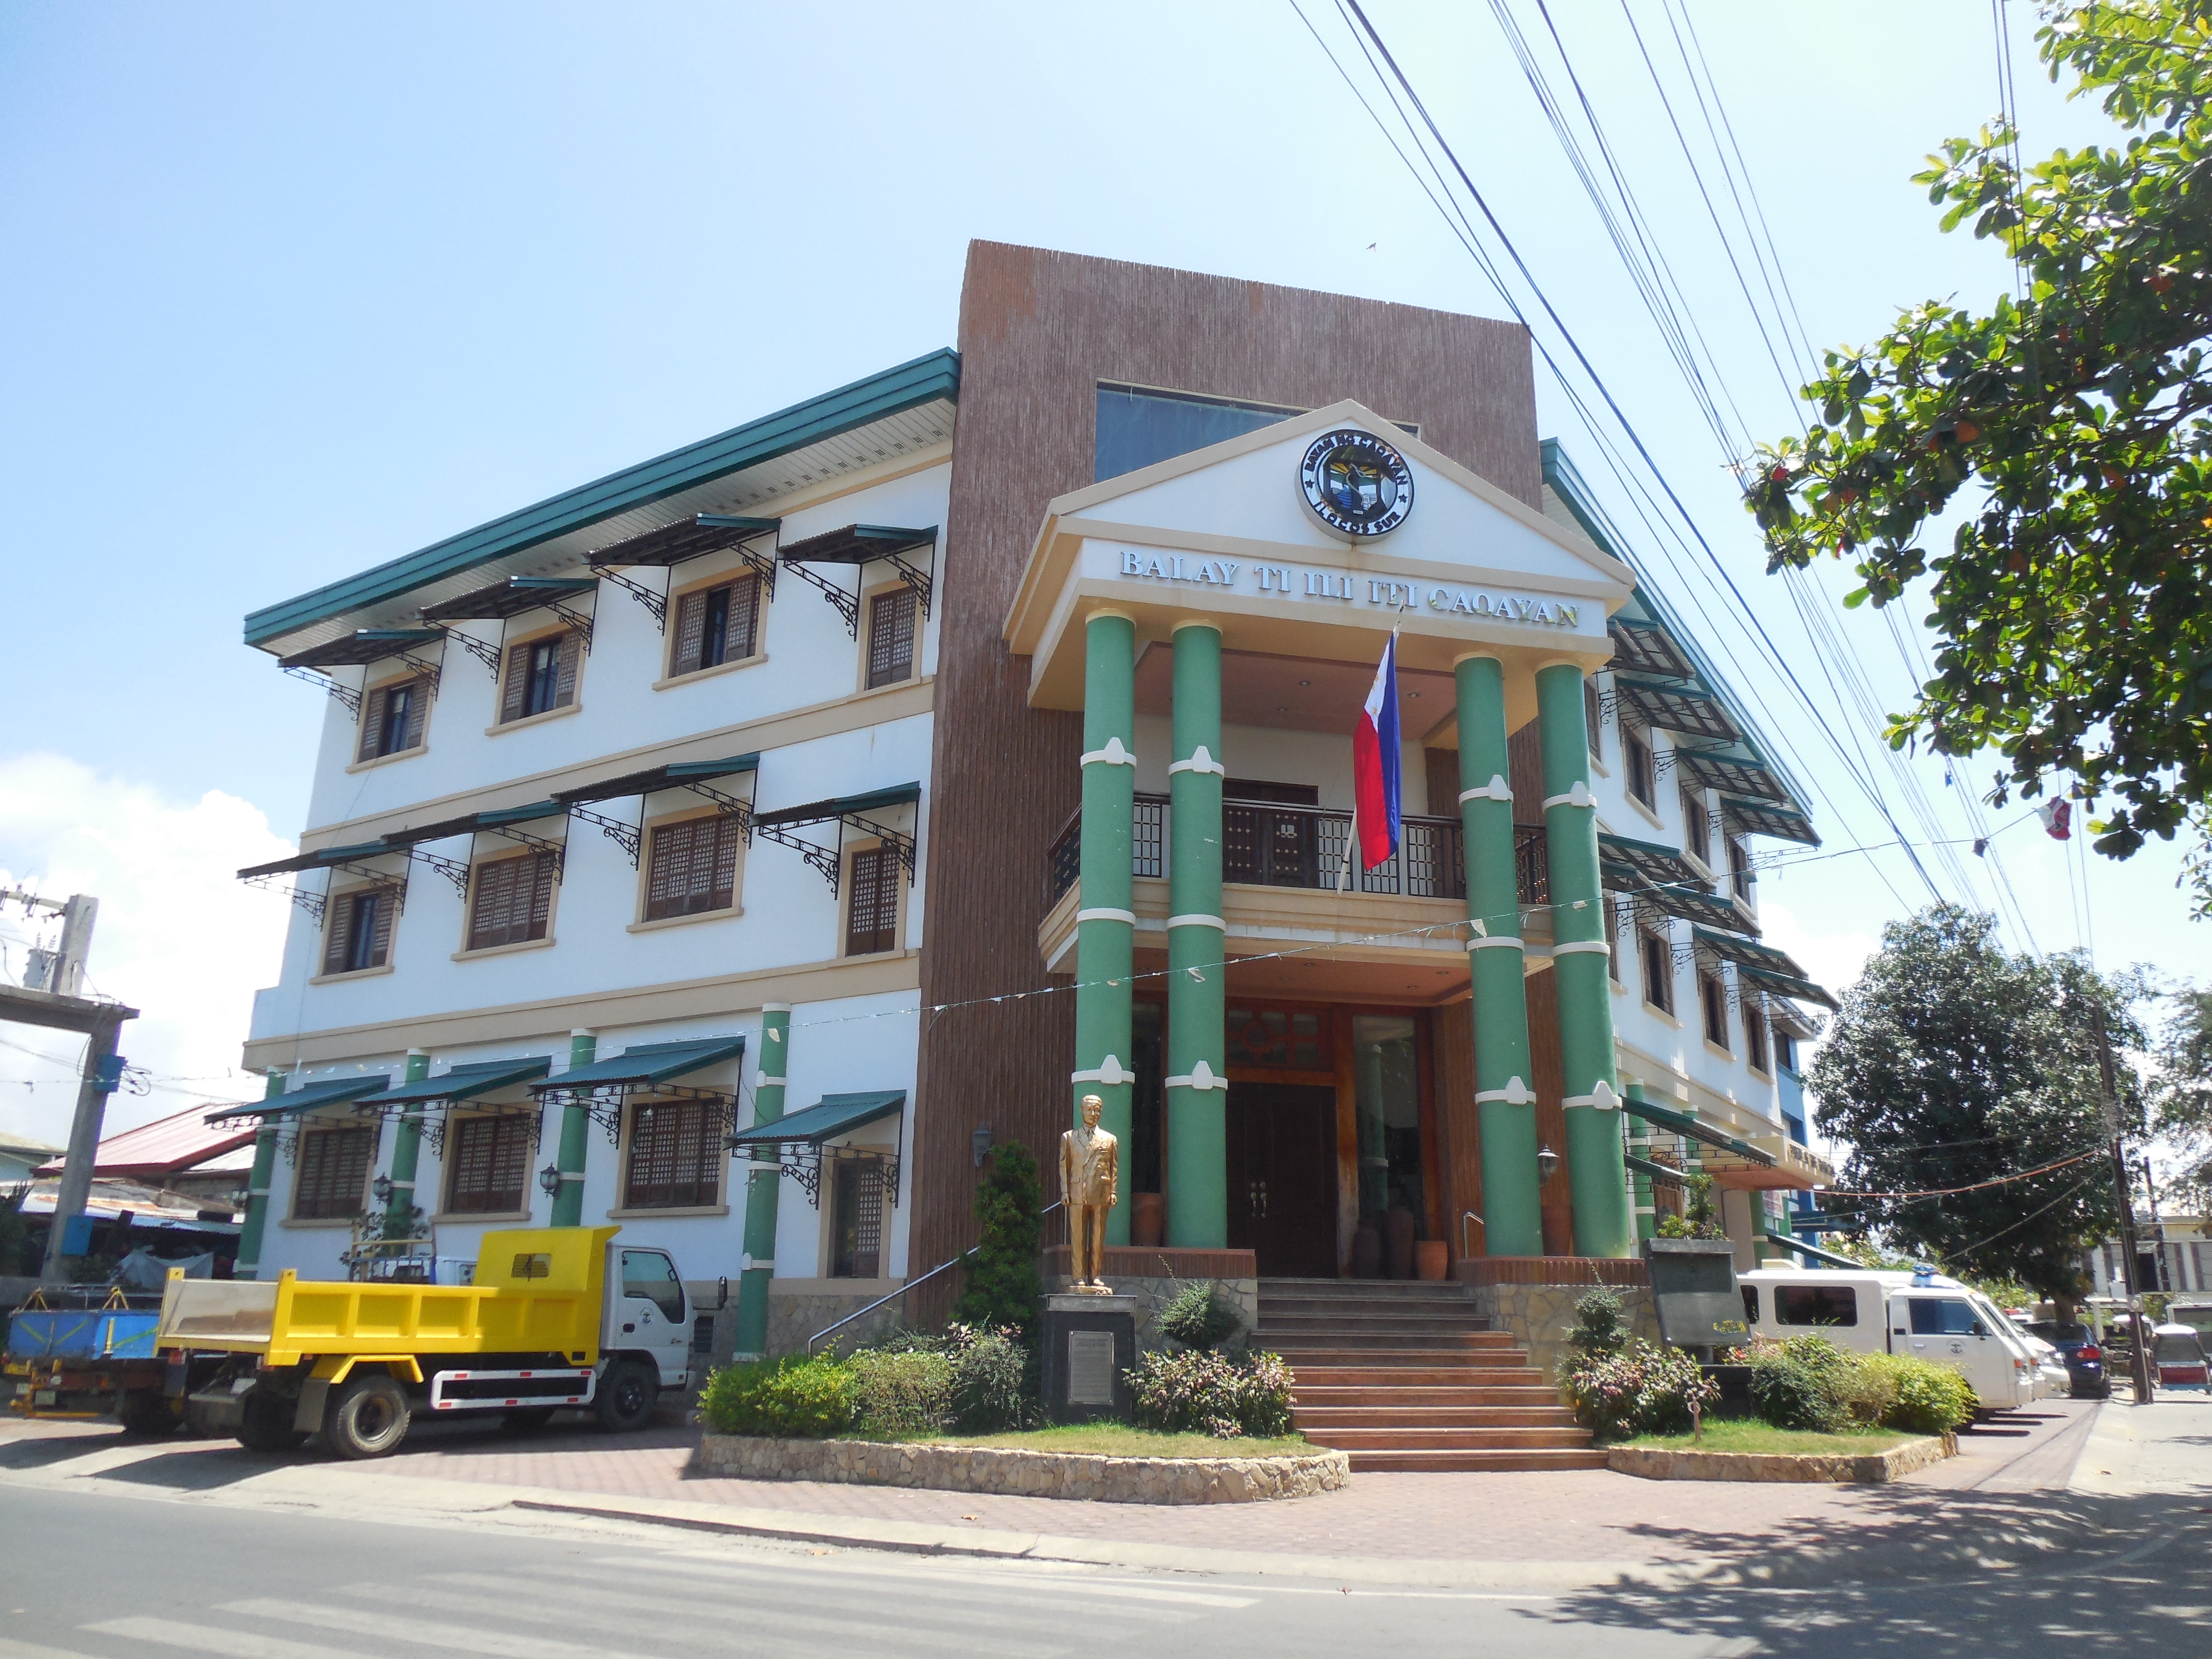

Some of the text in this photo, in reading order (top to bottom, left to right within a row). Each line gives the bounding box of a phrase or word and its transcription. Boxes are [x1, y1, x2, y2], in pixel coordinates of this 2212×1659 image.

[1313, 501, 1401, 534] ILOCOS SUR
[1120, 551, 1581, 627] BALAY TI ILI ITI CAOAYAN
